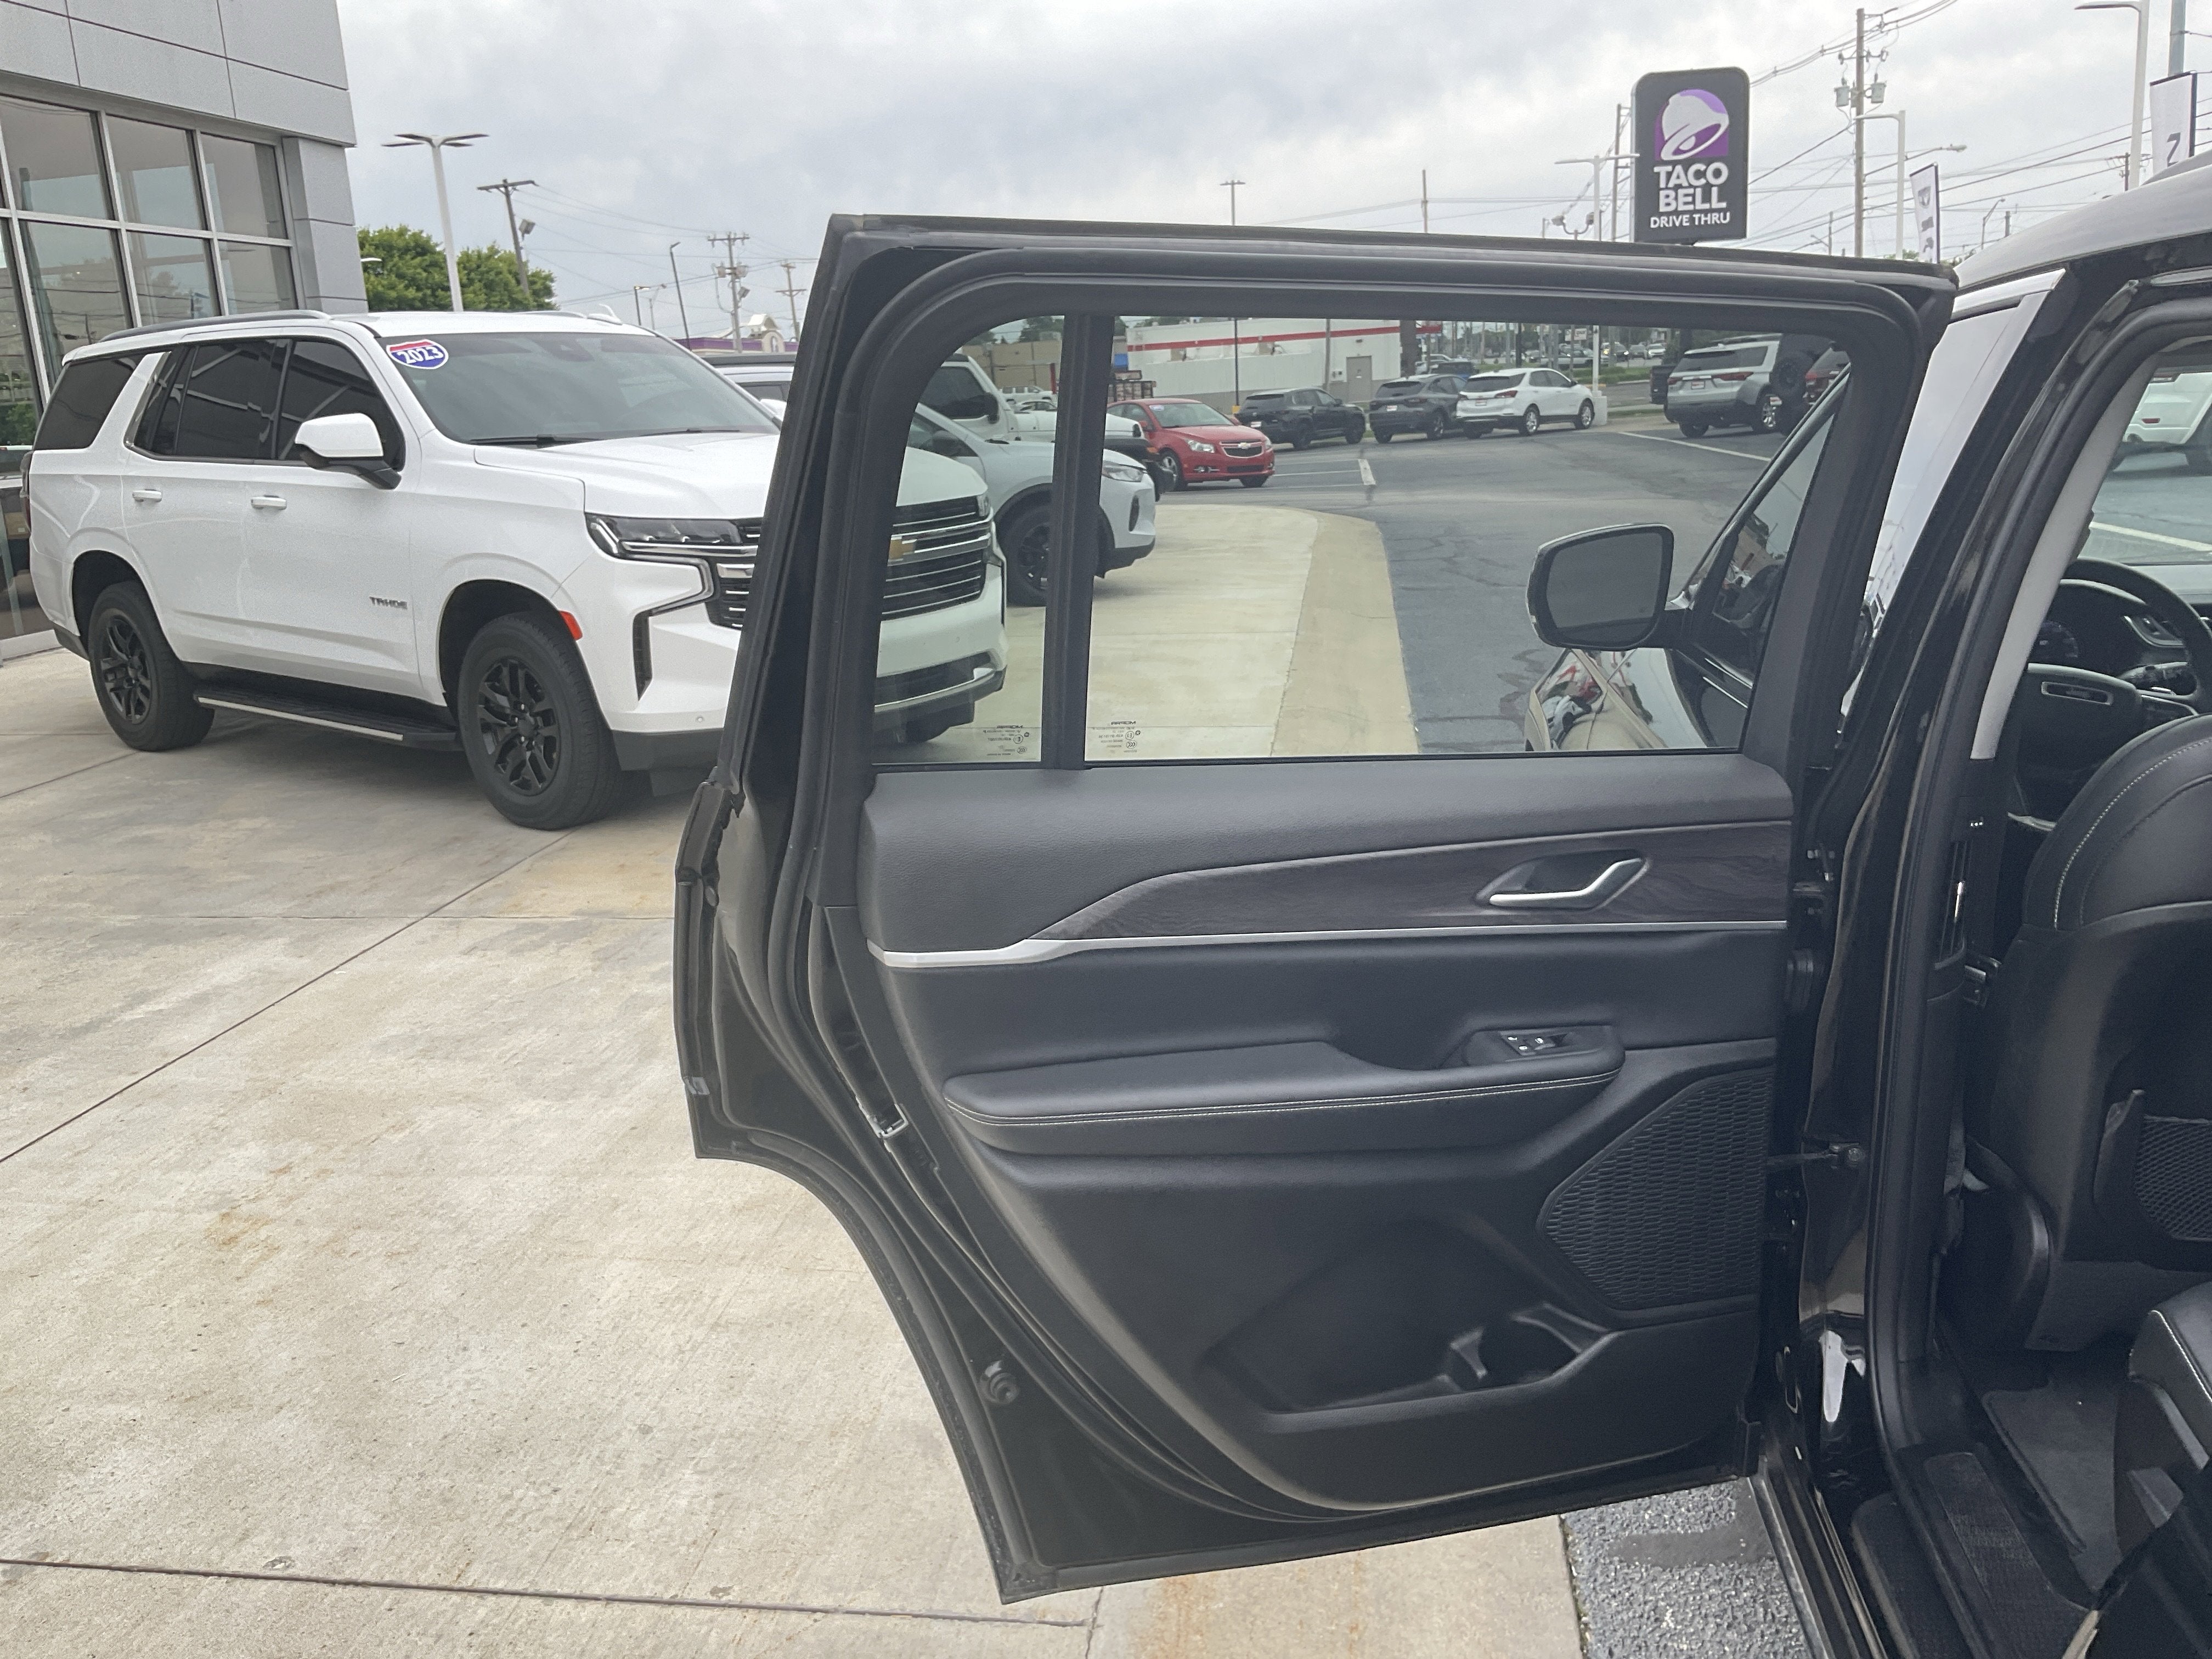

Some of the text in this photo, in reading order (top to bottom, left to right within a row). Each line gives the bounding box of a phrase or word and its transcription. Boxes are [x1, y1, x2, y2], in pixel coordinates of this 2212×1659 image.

[1654, 162, 1728, 188] TACO
[1659, 187, 1727, 212] BELL
[1650, 212, 1730, 228] DRIVE THRU
[398, 346, 444, 364] 2023
[369, 596, 408, 610] TAHOE
